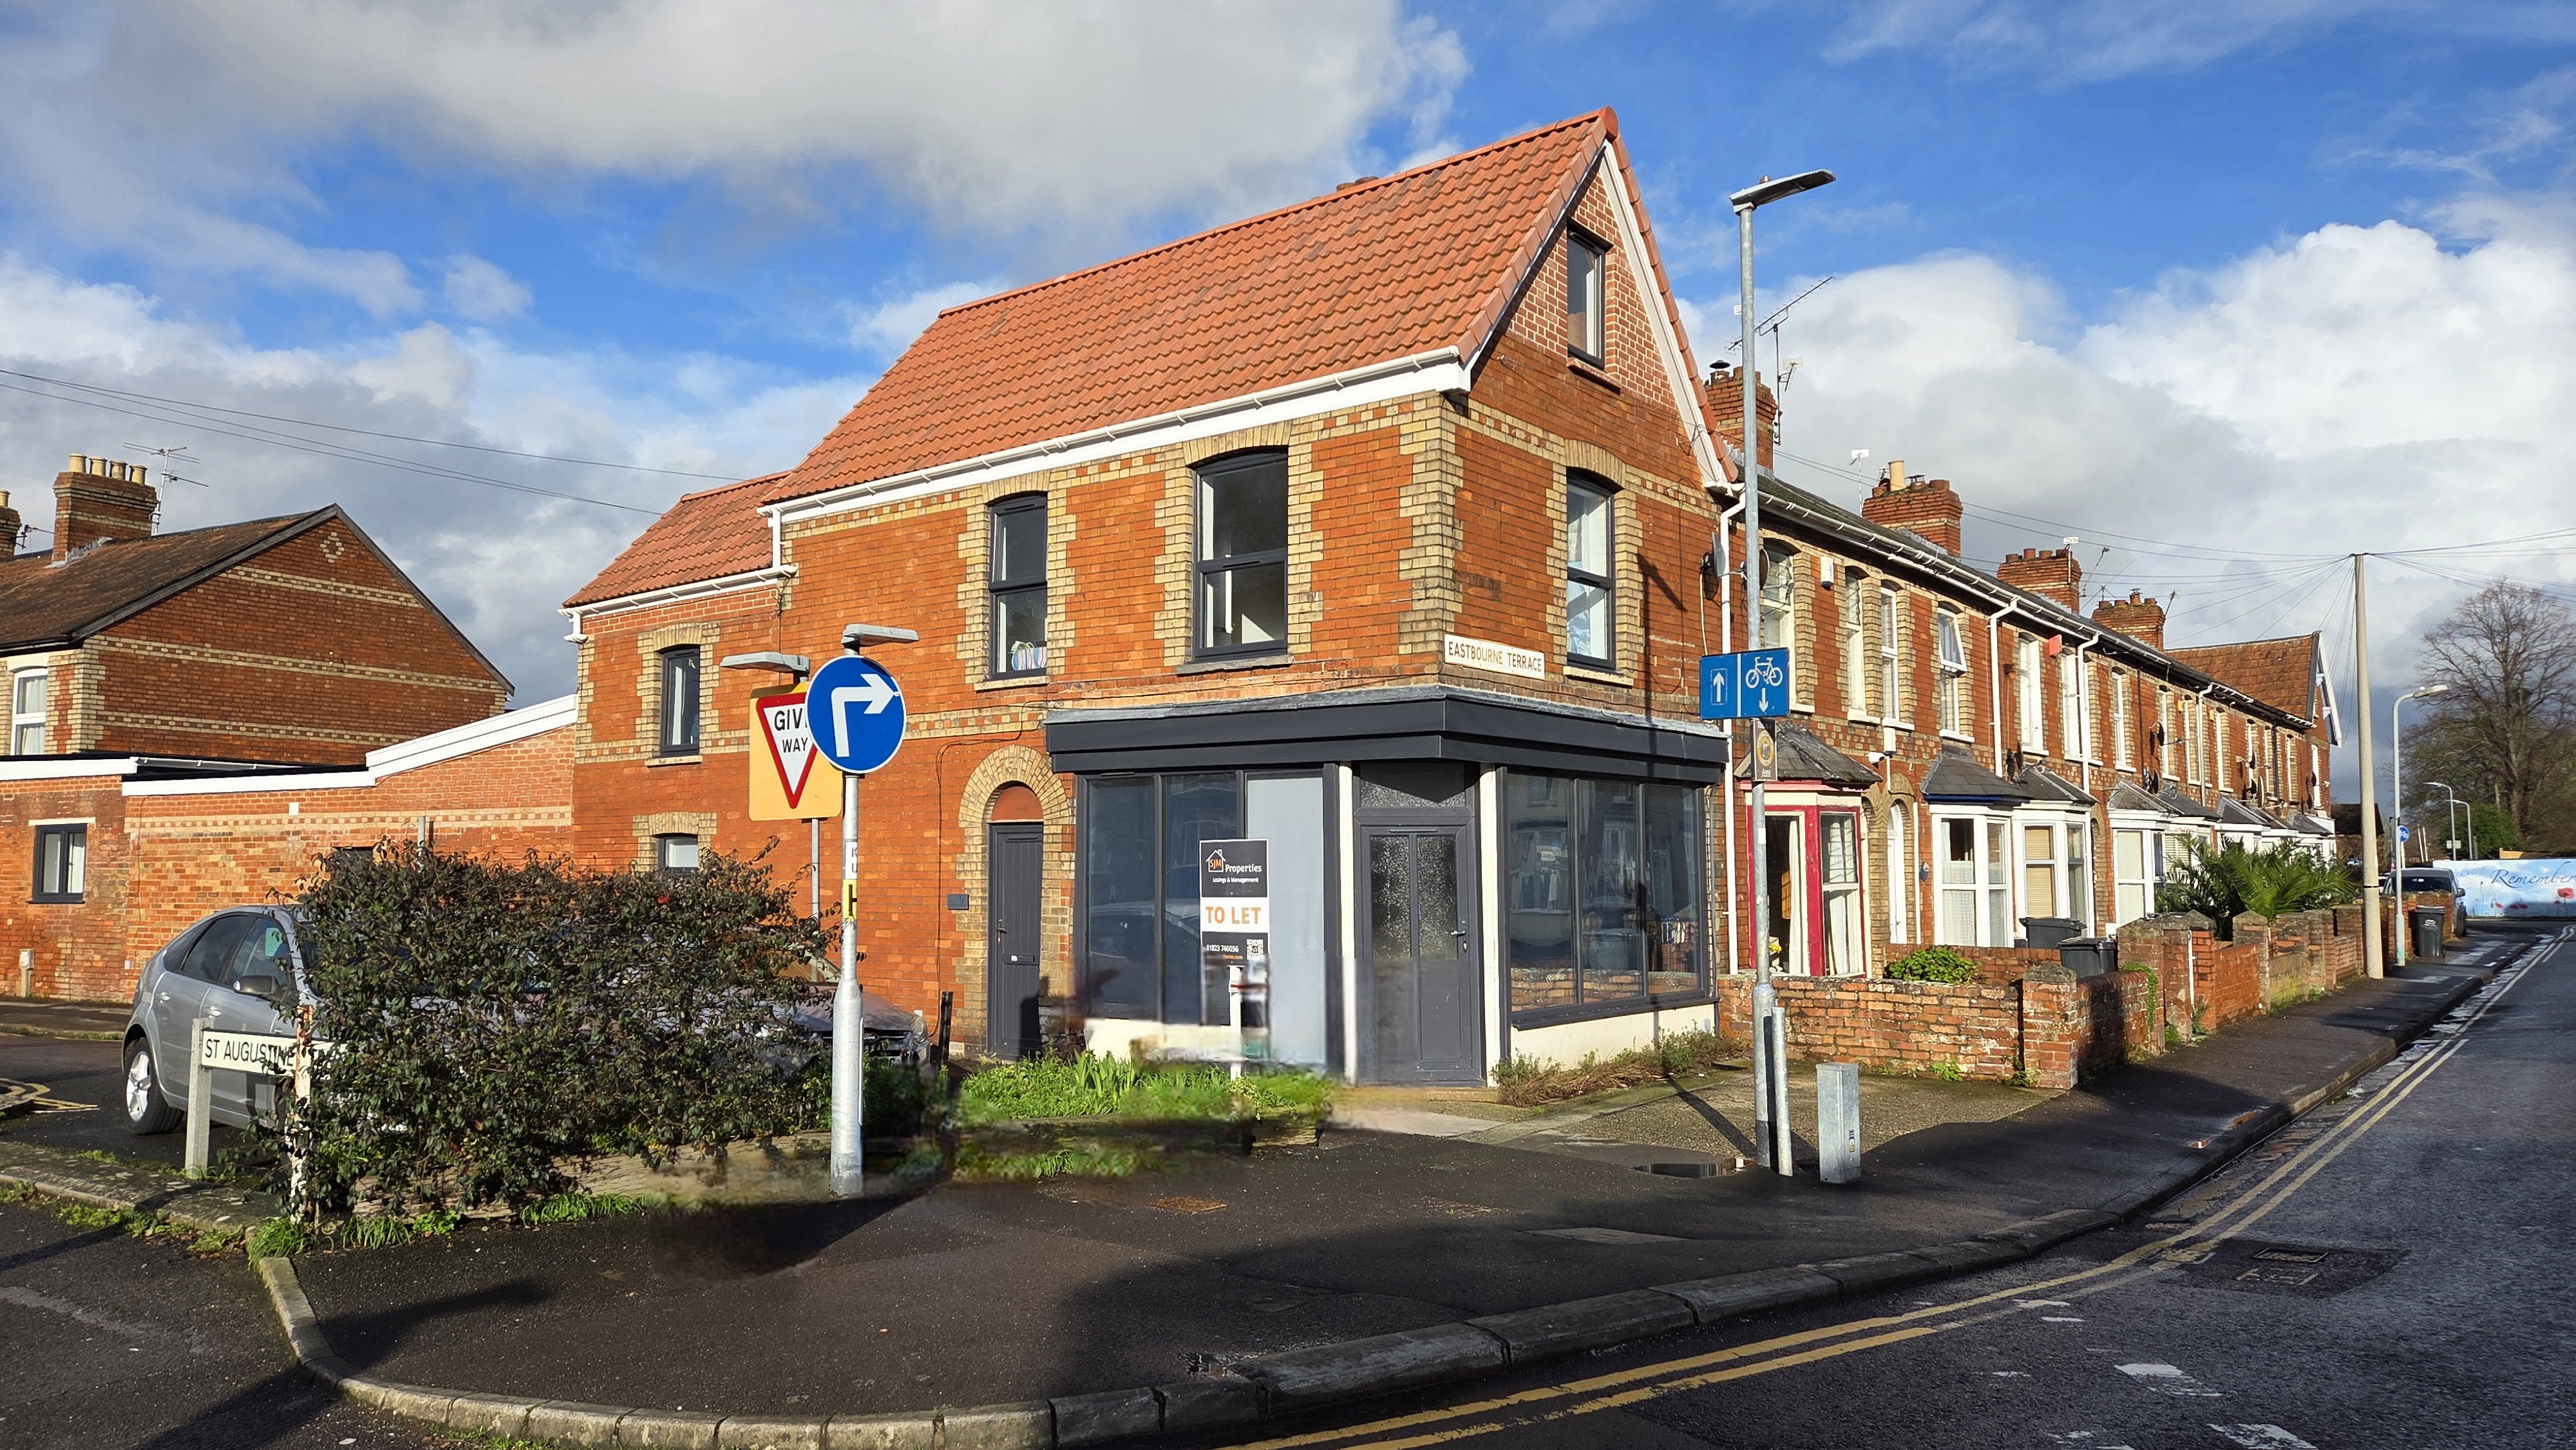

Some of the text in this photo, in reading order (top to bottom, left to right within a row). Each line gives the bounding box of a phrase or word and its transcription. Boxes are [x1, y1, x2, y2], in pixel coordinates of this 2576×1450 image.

[1448, 641, 1542, 672] EASTBOURNE TERRACE
[774, 708, 808, 731] GIV
[782, 737, 808, 753] WAY
[1210, 859, 1262, 874] SJM Properties
[2491, 861, 2576, 889] Remember
[1206, 906, 1261, 925] TO LET
[205, 1039, 220, 1059] ST
